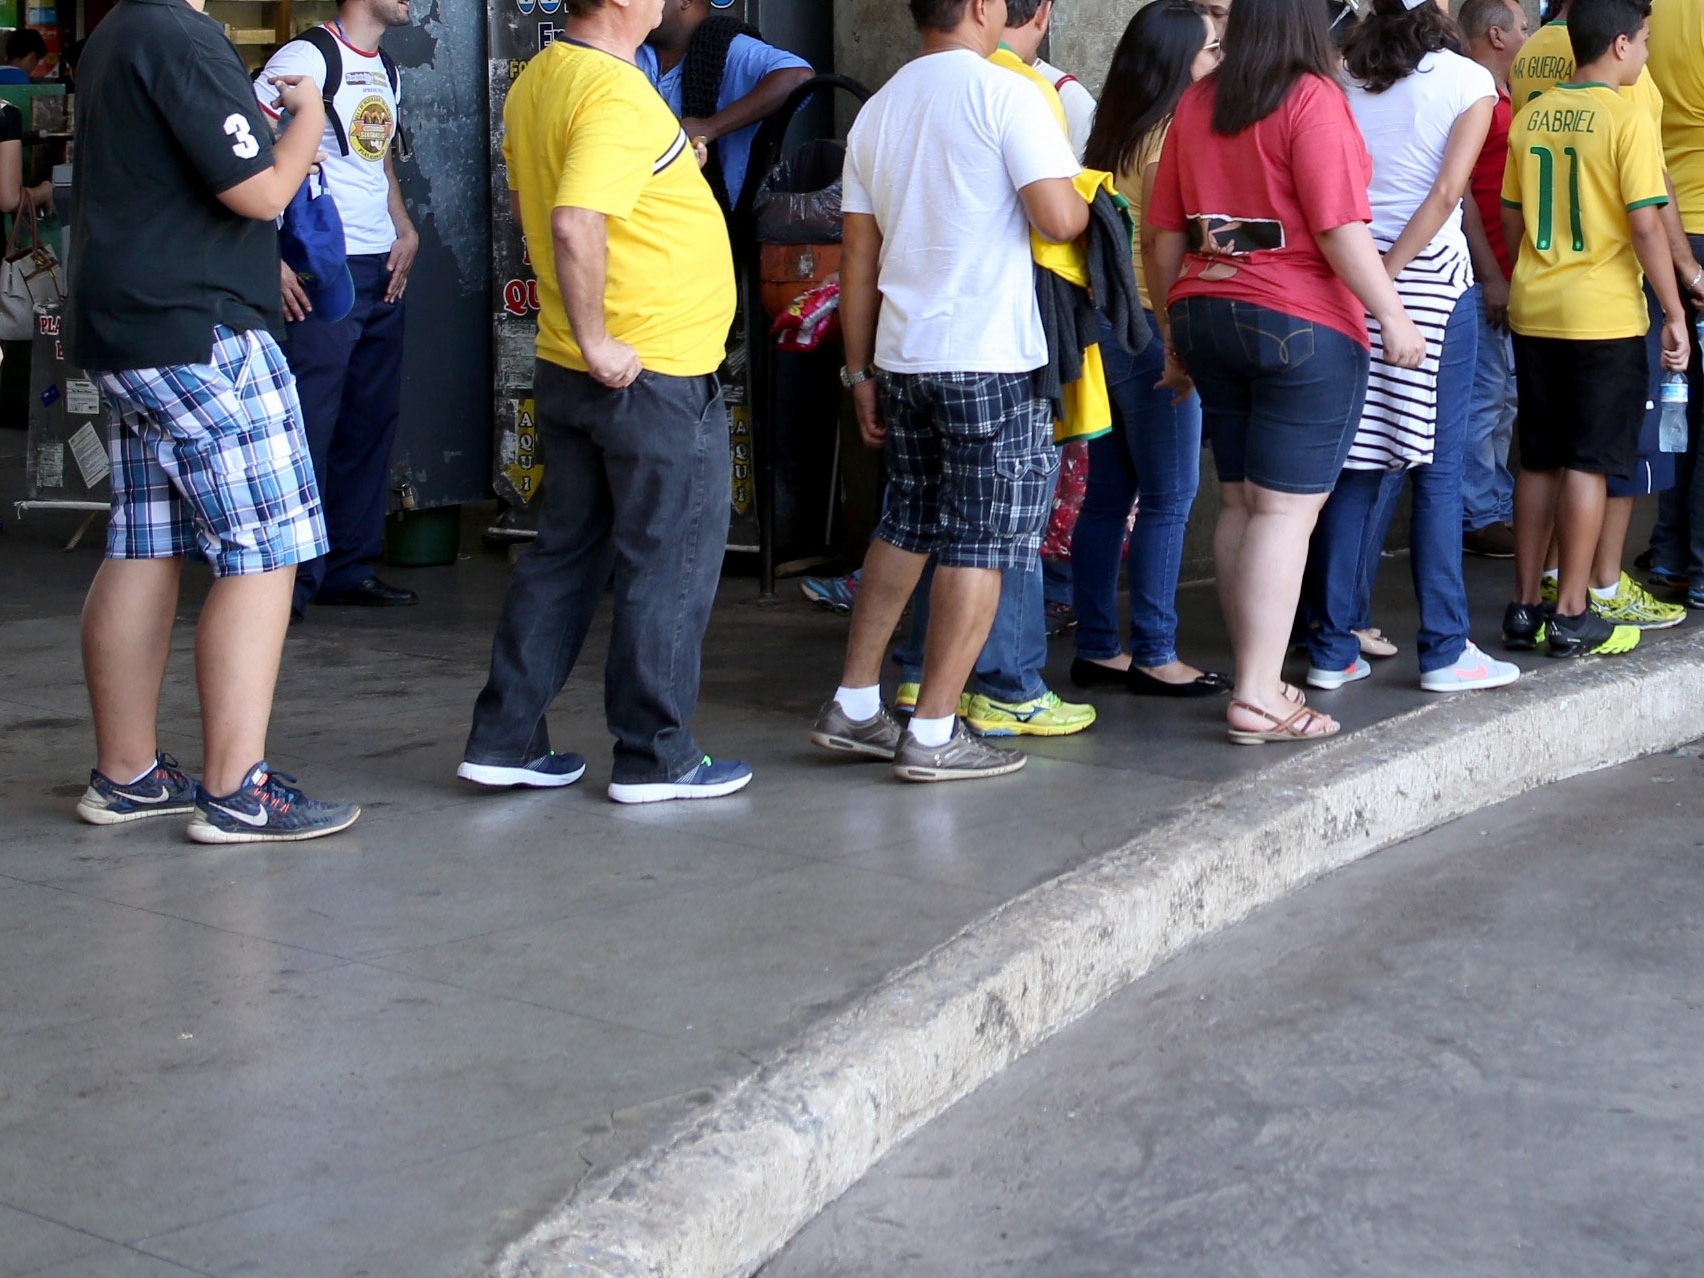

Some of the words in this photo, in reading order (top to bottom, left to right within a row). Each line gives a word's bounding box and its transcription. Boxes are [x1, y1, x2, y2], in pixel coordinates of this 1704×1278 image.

[1528, 55, 1573, 81] GUERRA
[223, 112, 260, 160] 3
[1527, 109, 1596, 134] GABRIEL
[1529, 145, 1584, 253] 11
[519, 412, 533, 492] AQUI
[735, 420, 747, 502] AQUI
